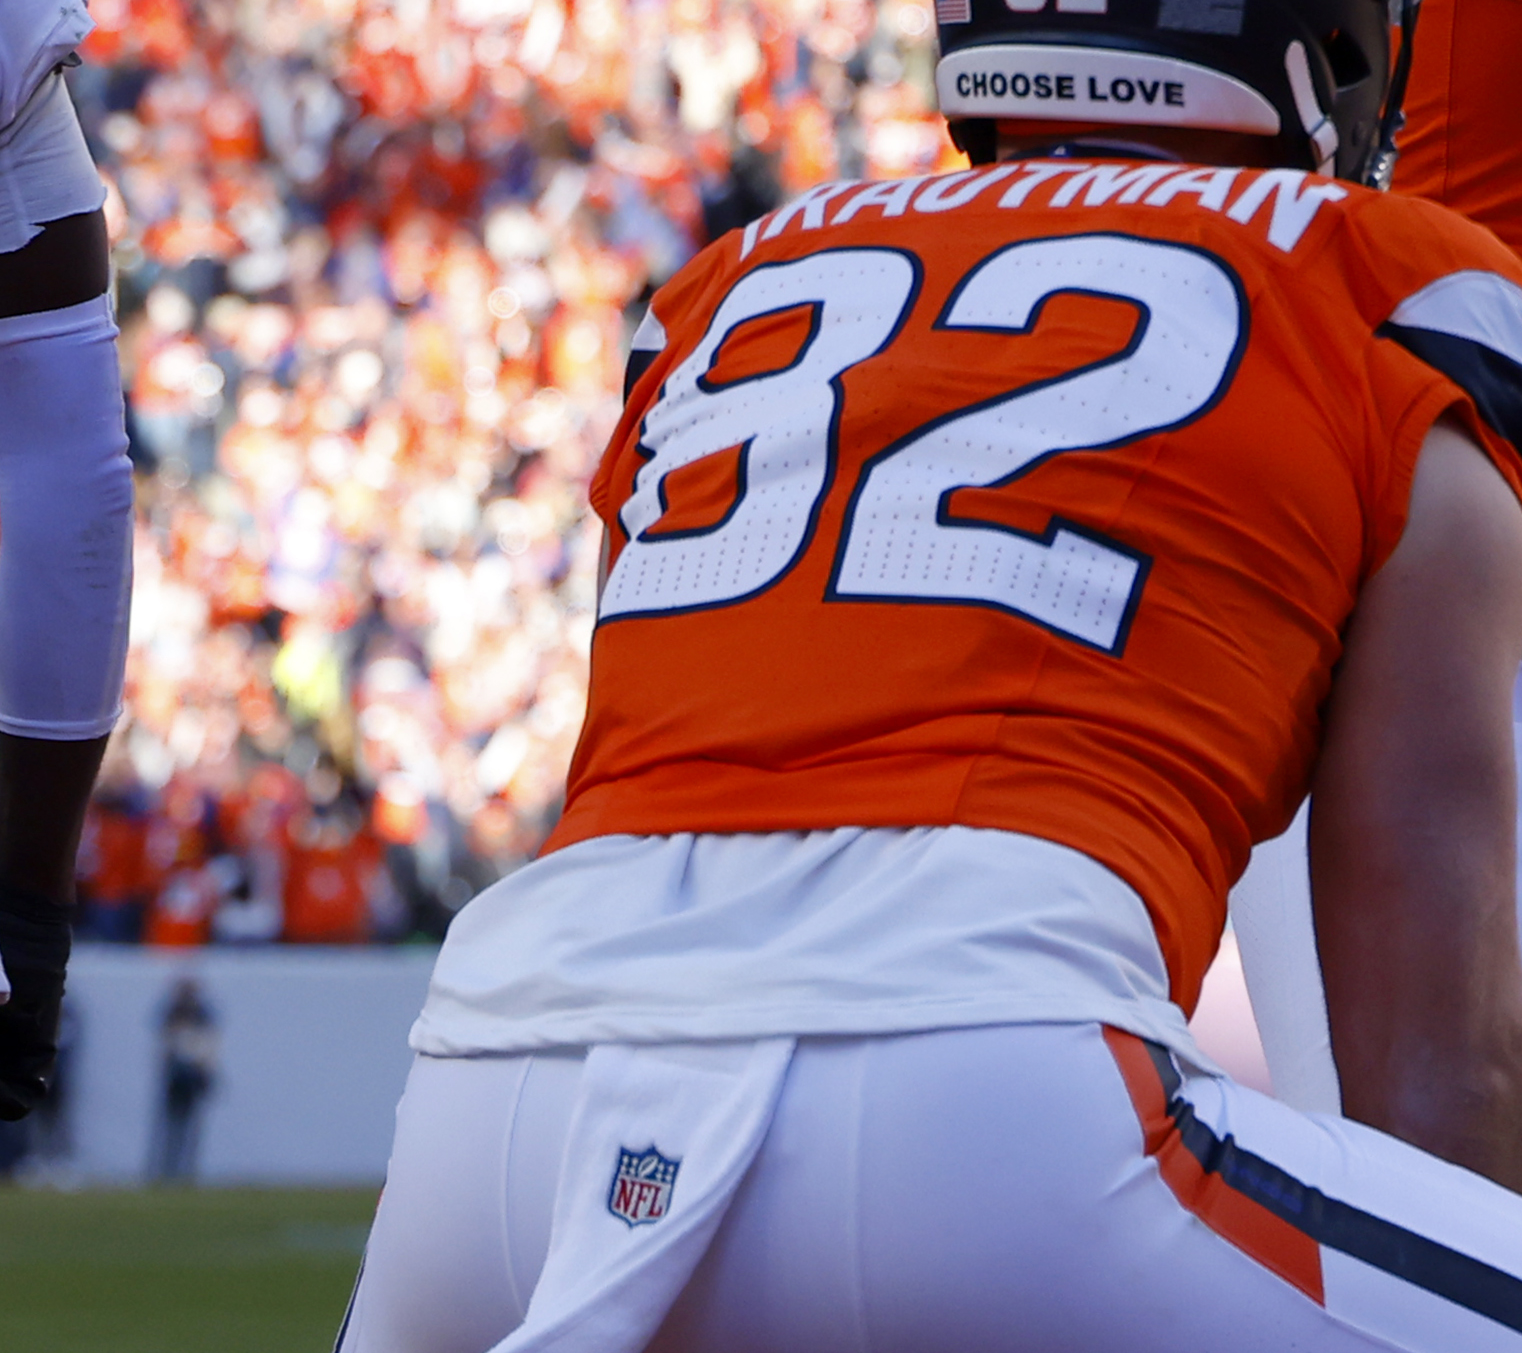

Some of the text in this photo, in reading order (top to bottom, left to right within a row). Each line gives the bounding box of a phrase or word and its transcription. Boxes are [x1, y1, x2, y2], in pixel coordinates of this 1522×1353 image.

[956, 72, 1186, 108] CHOOSE LOVE
[597, 230, 1249, 658] 82
[615, 1177, 665, 1219] NFL
